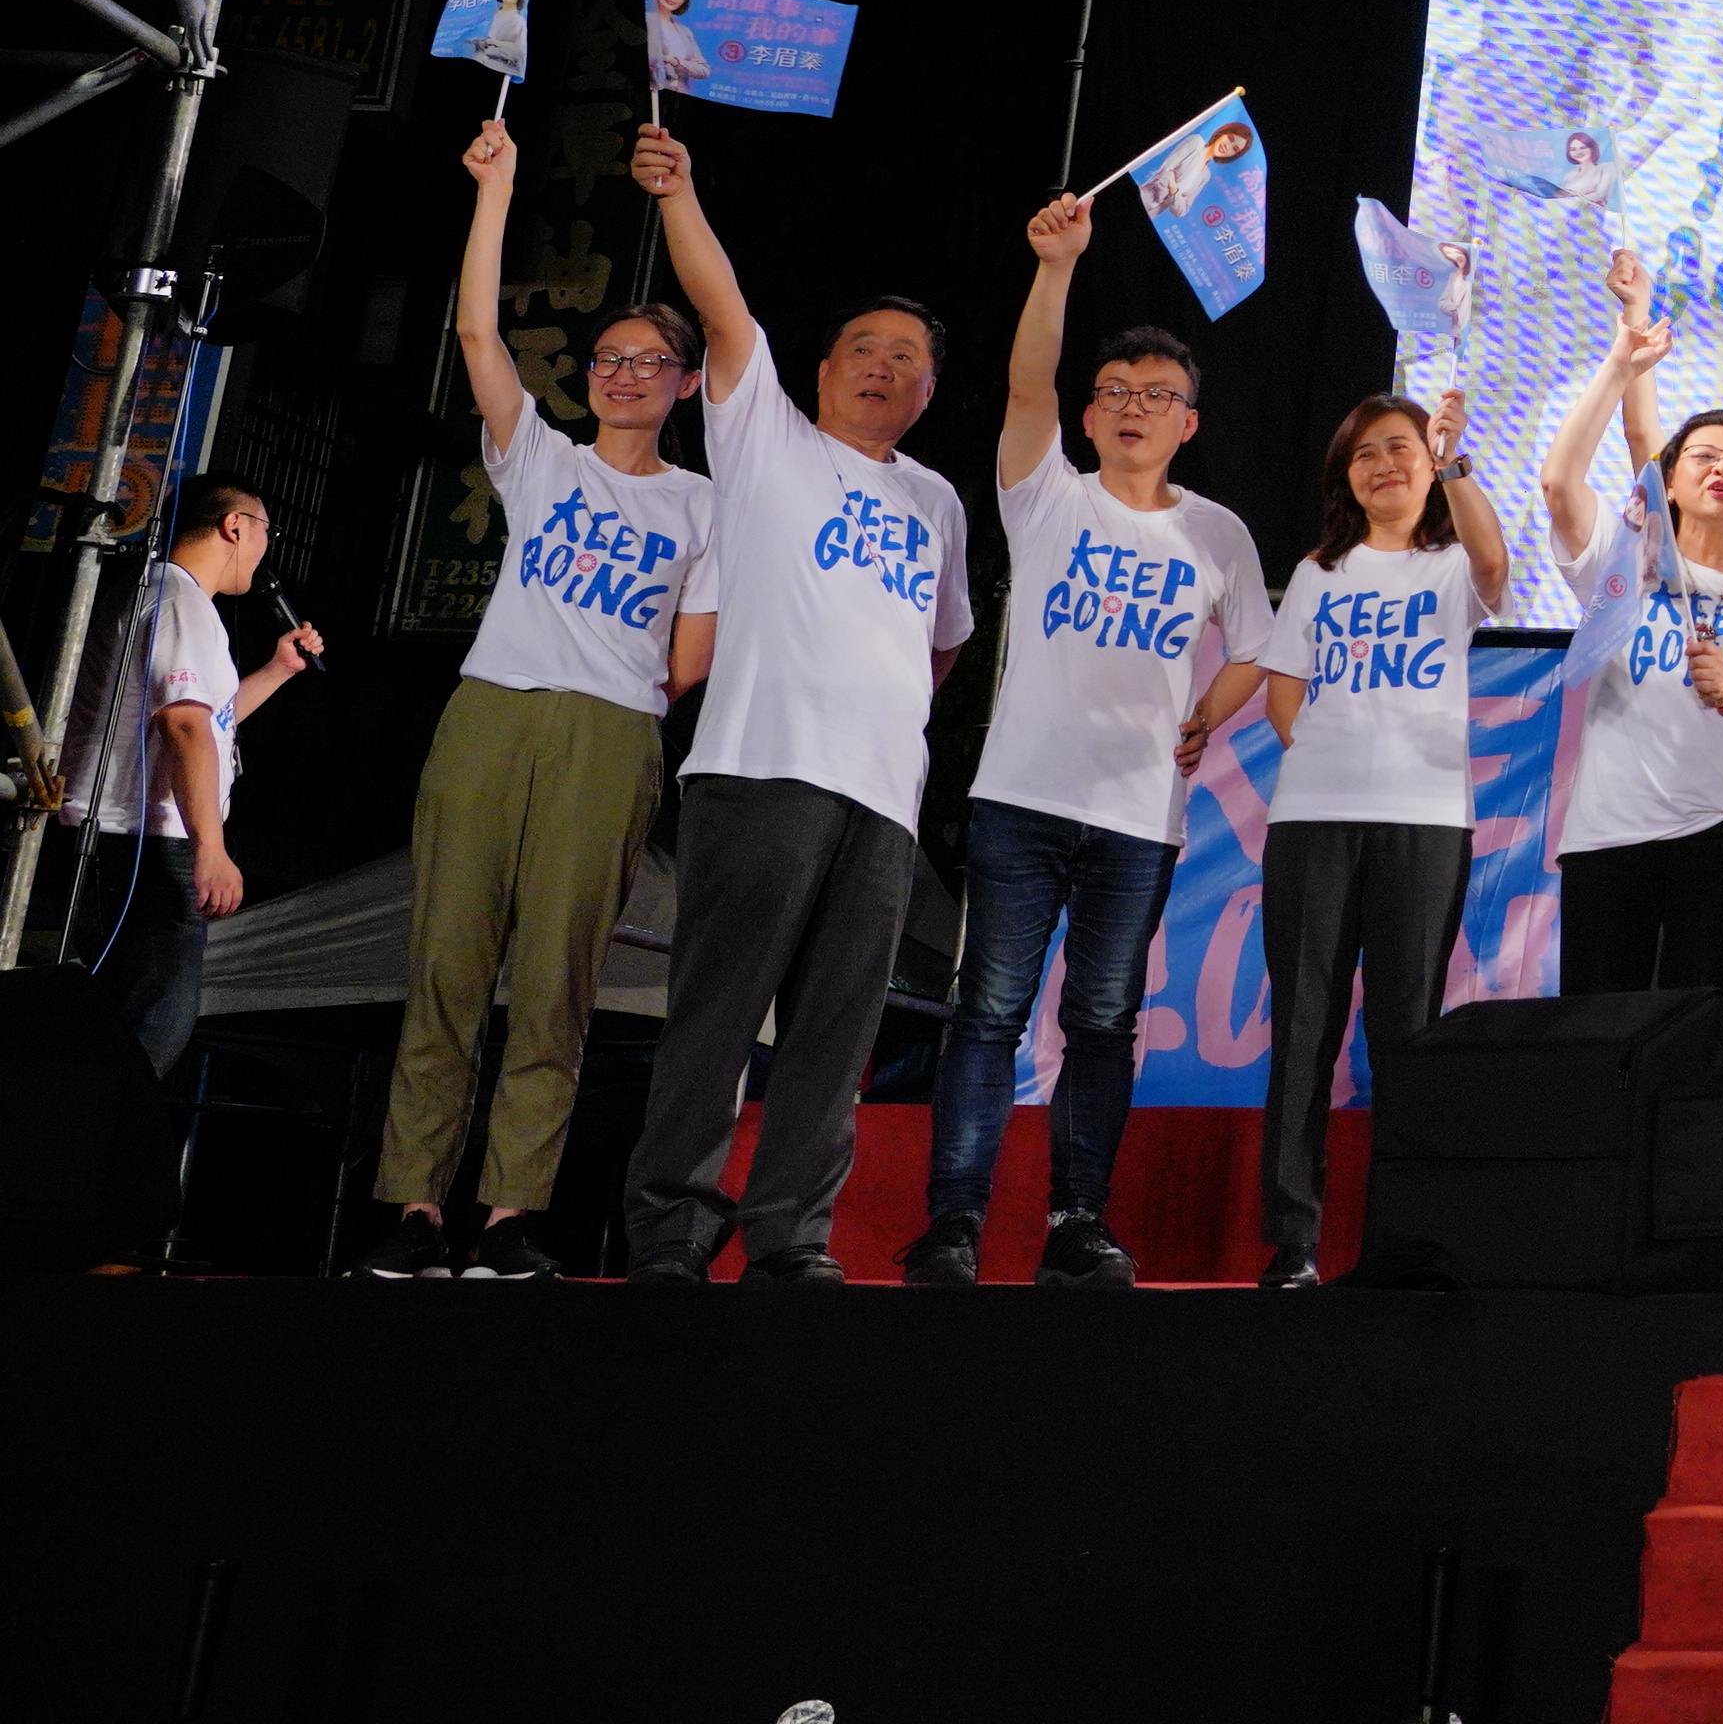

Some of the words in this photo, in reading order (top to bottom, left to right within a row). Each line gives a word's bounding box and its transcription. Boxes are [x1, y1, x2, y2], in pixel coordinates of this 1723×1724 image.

[543, 487, 676, 574] KEEP
[1067, 530, 1196, 605] KEEP
[1313, 590, 1437, 643] KEEP
